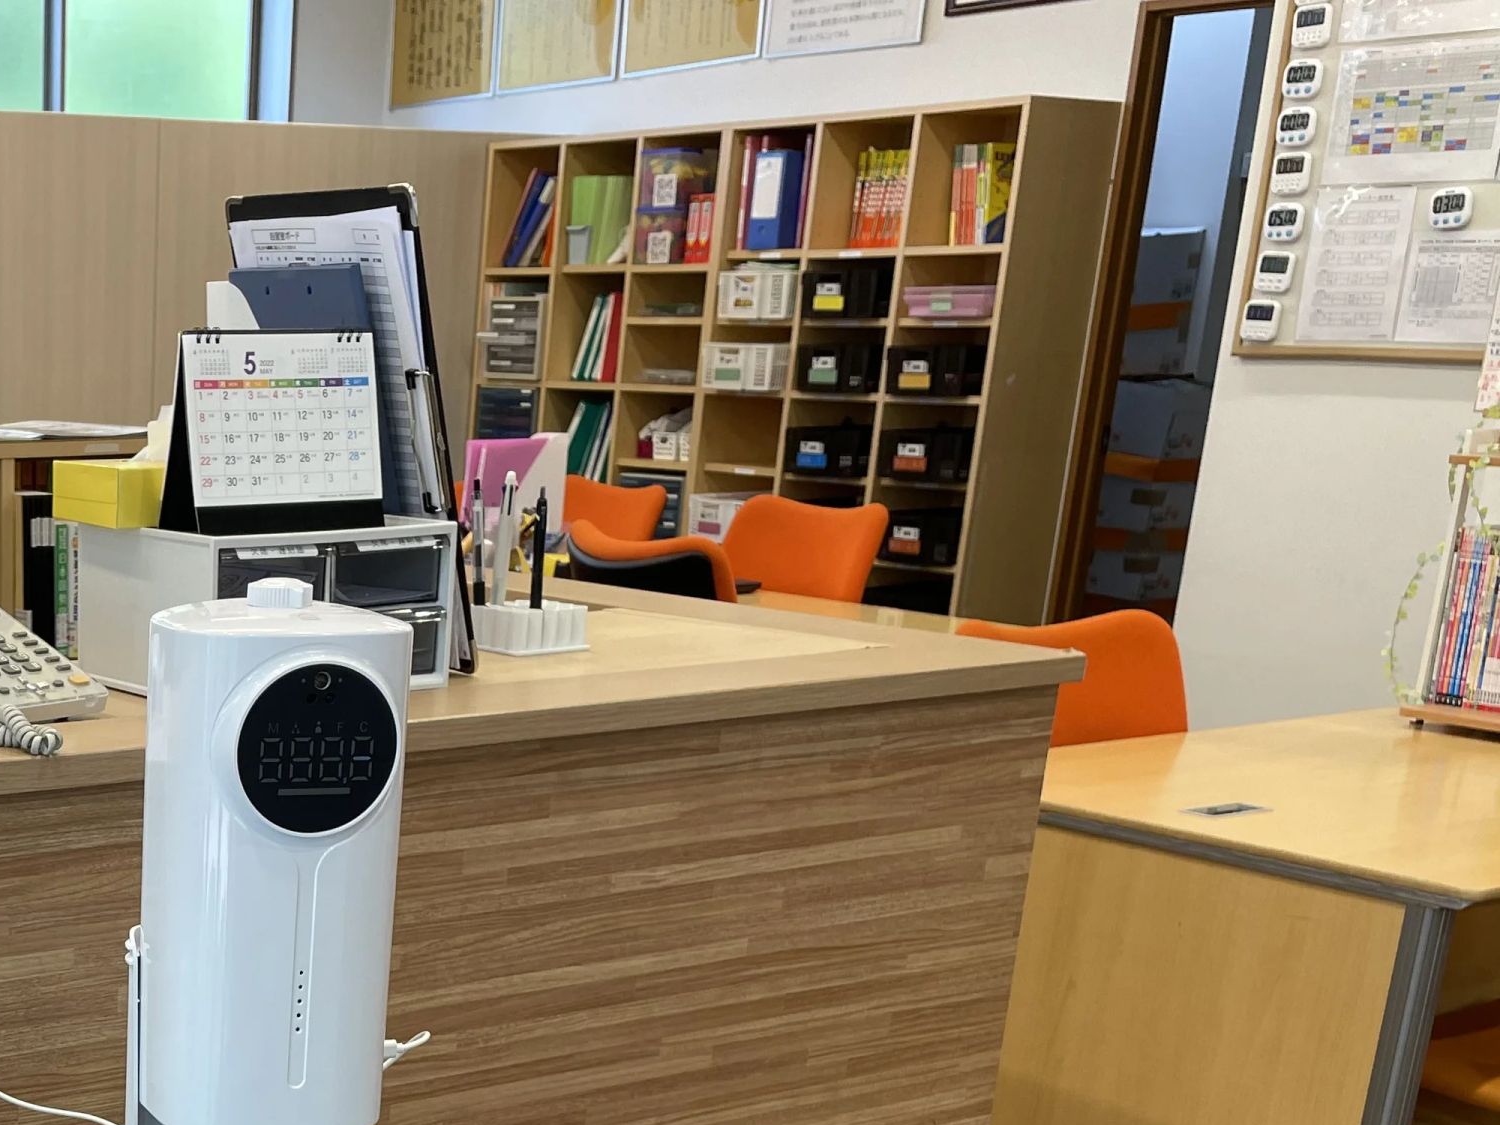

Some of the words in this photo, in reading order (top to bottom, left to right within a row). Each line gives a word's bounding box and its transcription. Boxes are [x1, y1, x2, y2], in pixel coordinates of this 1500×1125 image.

[243, 351, 256, 375] 5
[223, 391, 228, 400] 2
[322, 388, 329, 398] 6
[224, 412, 230, 422] 9
[248, 412, 258, 421] 10
[273, 411, 282, 421] 11
[298, 410, 307, 420] 12
[322, 410, 333, 419] 13
[347, 409, 357, 418] 14
[200, 434, 210, 444] 15
[225, 434, 235, 443] 16
[250, 433, 259, 442] 17
[275, 433, 285, 442] 18
[300, 431, 309, 441] 19
[323, 431, 334, 440] 20
[347, 430, 357, 440] 21
[200, 456, 211, 466] 22
[225, 455, 236, 465] 23
[250, 455, 261, 464] 24
[275, 454, 286, 463] 25
[300, 453, 311, 462] 26
[324, 452, 335, 462] 27
[349, 451, 360, 461] 28
[202, 478, 213, 488] 29
[226, 477, 238, 487] 30
[252, 476, 261, 486] 31
